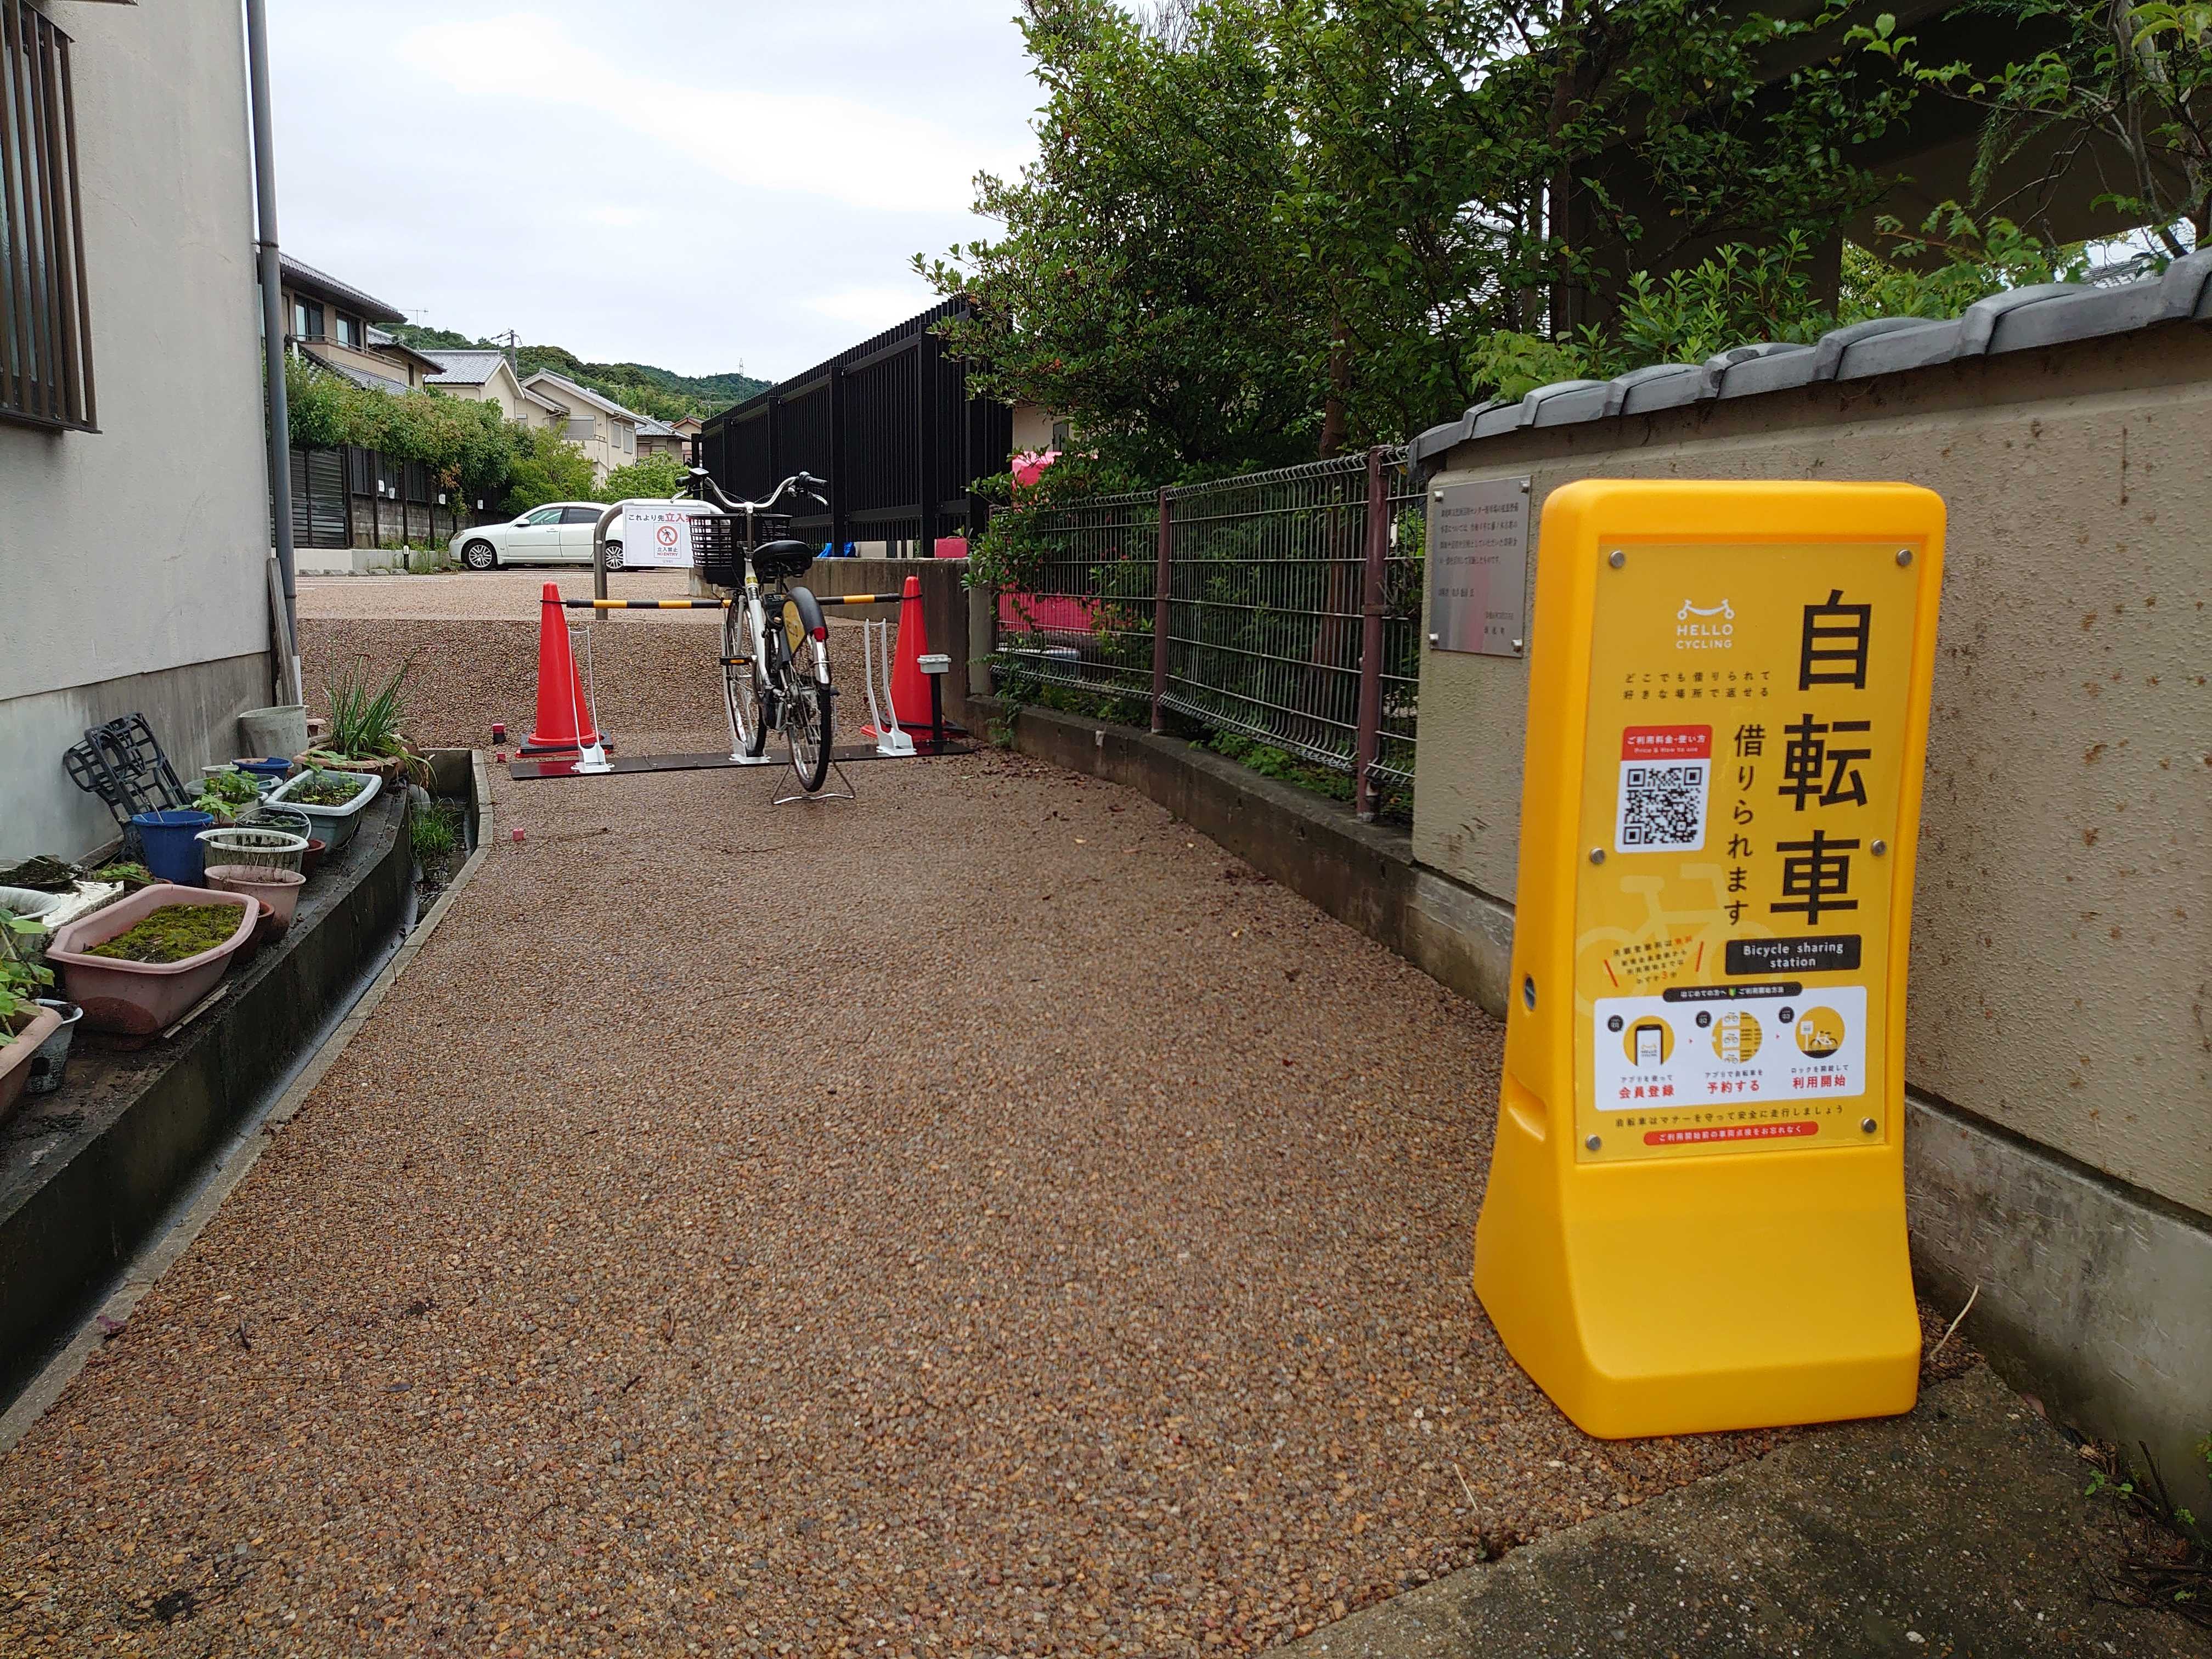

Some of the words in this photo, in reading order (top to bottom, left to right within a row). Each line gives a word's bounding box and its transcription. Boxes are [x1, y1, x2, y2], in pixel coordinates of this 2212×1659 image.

[1677, 624, 1734, 636] HELLO
[1676, 640, 1733, 649] CYCLING
[1625, 670, 1770, 683] どこでも借りられて
[1623, 687, 1769, 699] 好きな場所で返せる
[1770, 589, 1872, 925] 自転車
[1724, 724, 1766, 925] 借りられます
[1743, 944, 1790, 957] Bicycle
[1797, 941, 1844, 956] sharing
[1770, 956, 1816, 969] station
[1707, 1080, 1759, 1094] 予約する
[1792, 1074, 1846, 1089] 利用開始
[1620, 1084, 1674, 1099] 会員登録
